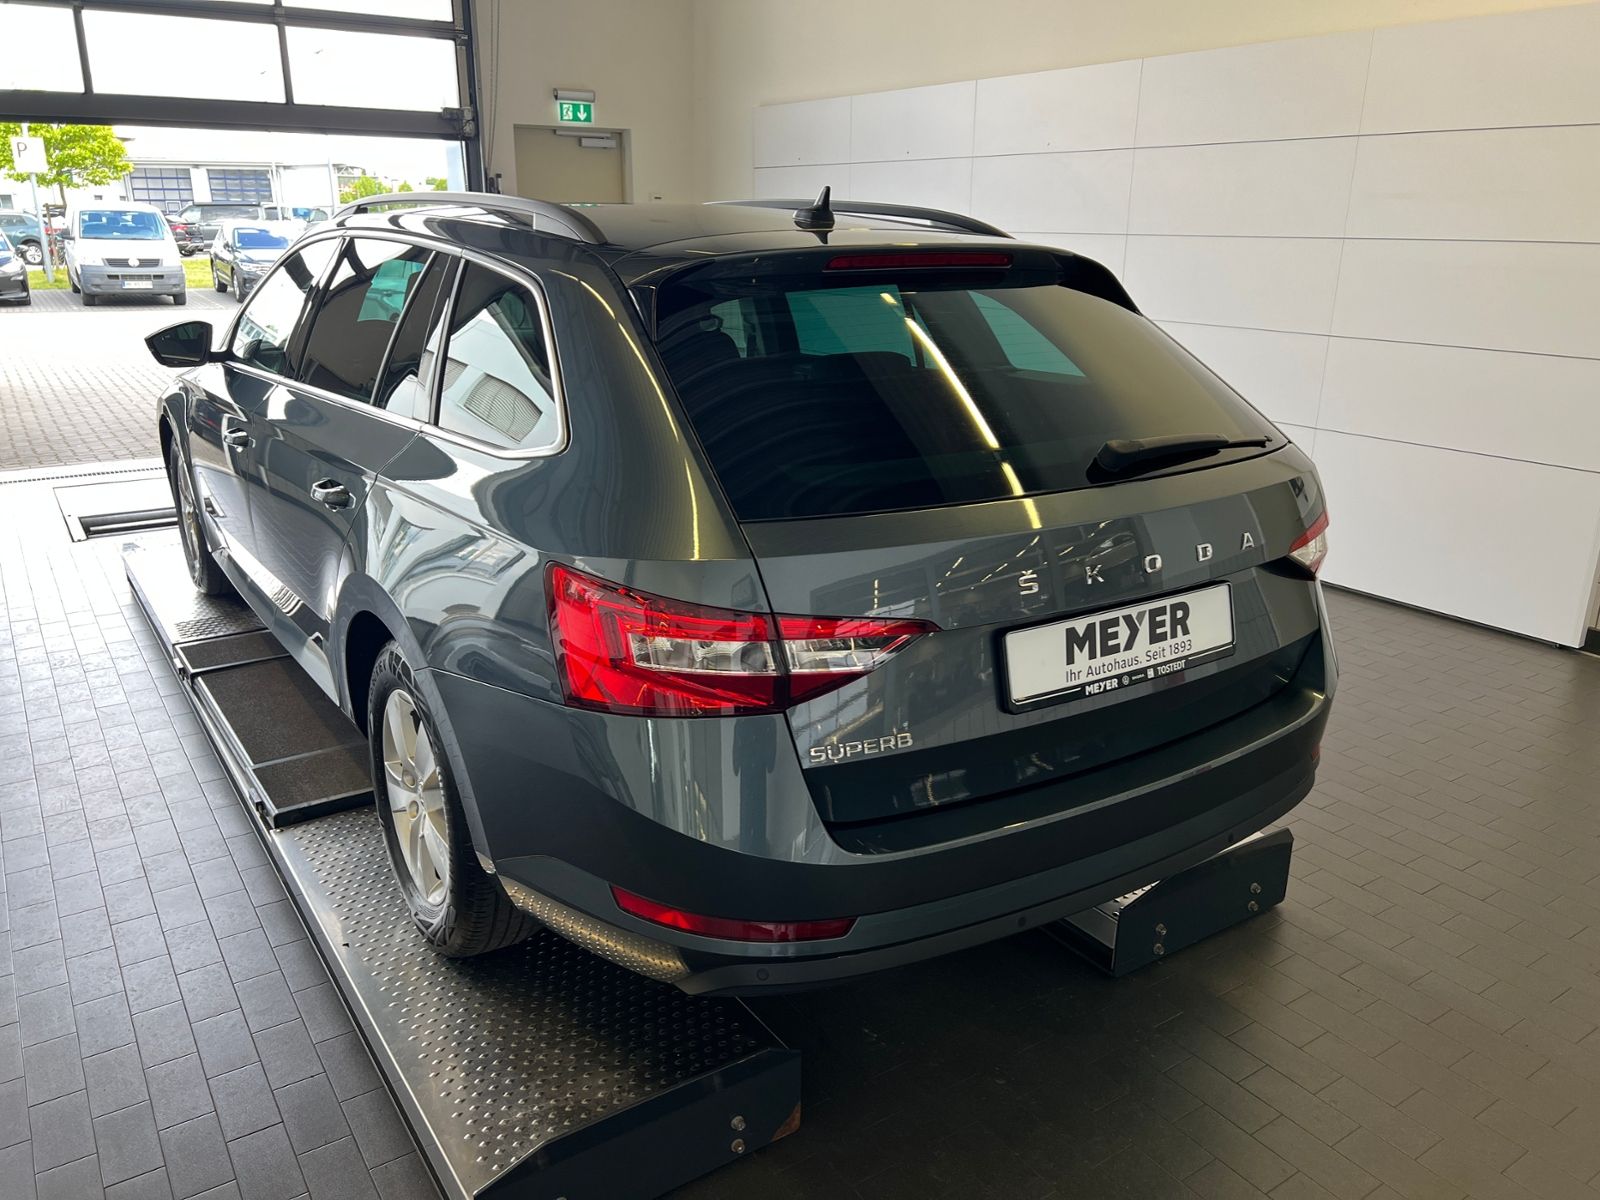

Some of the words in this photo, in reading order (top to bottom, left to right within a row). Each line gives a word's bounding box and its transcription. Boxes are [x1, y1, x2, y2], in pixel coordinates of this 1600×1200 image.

[16, 141, 28, 158] P
[1018, 532, 1256, 596] ŠKODA
[1065, 601, 1190, 666] MEYER
[1065, 668, 1083, 683] Ihr
[1086, 655, 1143, 678] Autohaus.
[1145, 647, 1167, 663] Seit
[1168, 639, 1193, 656] 1893
[1085, 678, 1119, 696] MEYER
[1156, 660, 1187, 676] TOSTEDT
[809, 732, 914, 763] SUPERB
